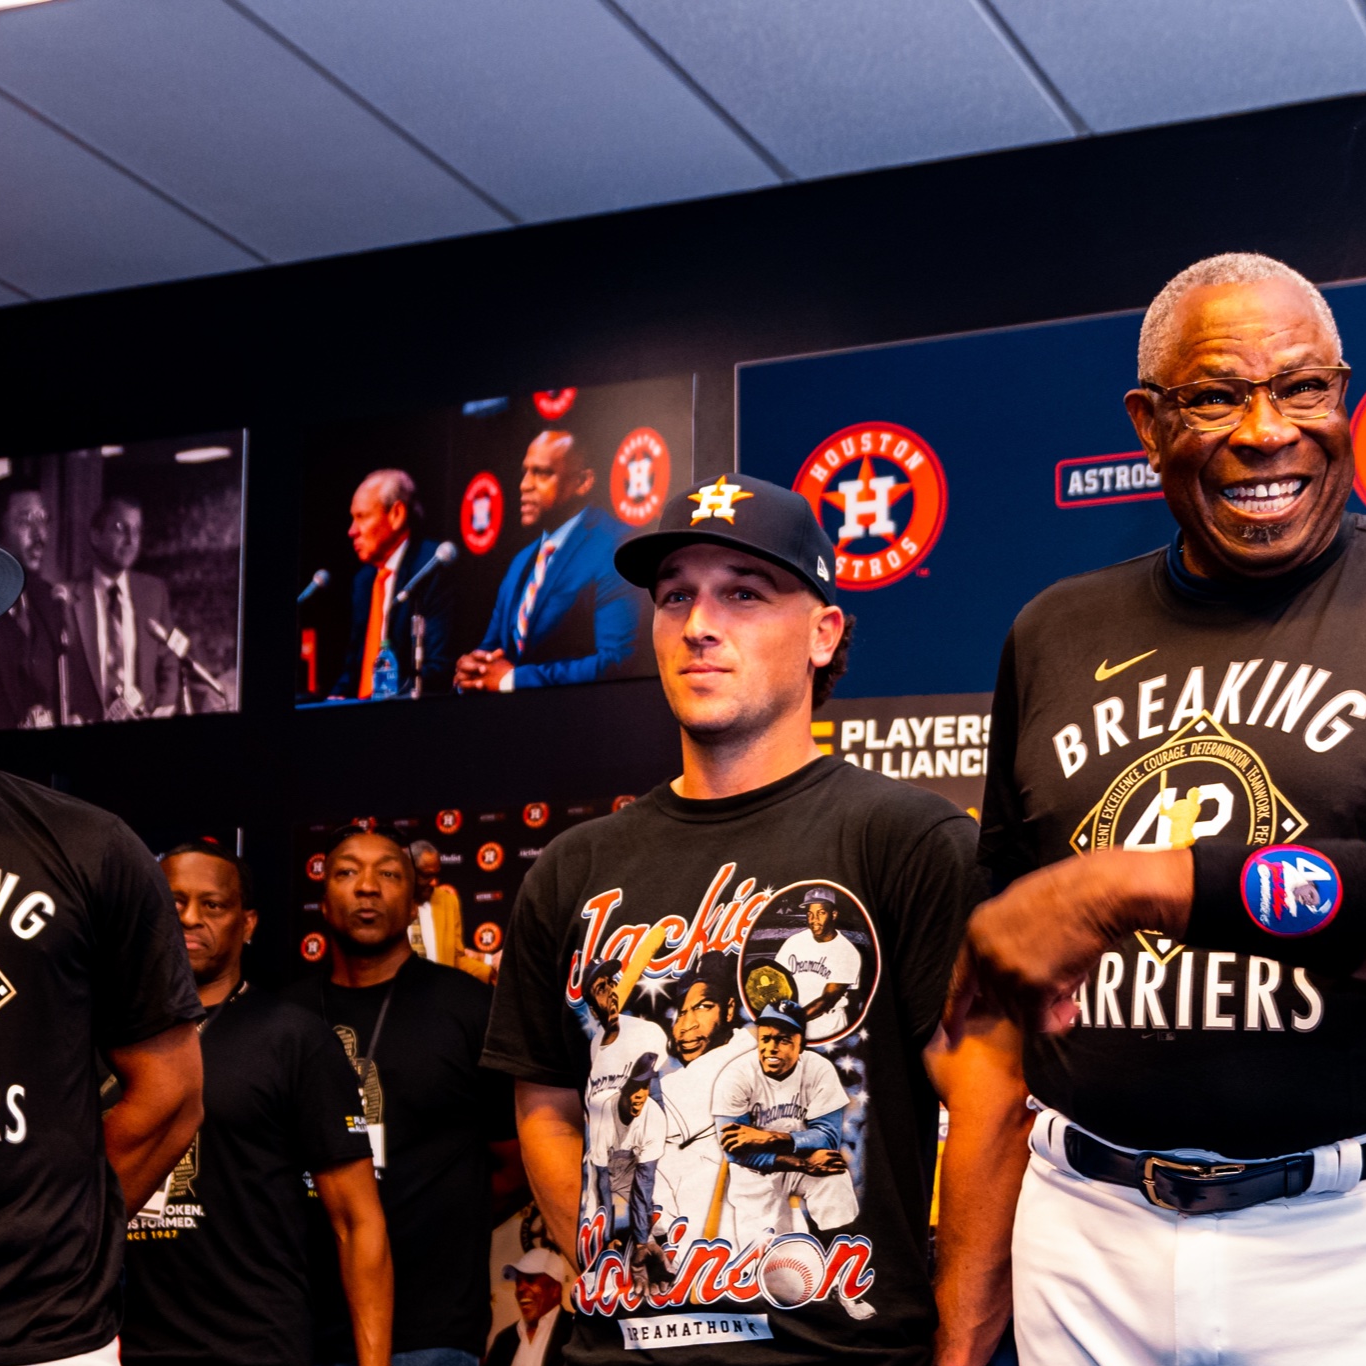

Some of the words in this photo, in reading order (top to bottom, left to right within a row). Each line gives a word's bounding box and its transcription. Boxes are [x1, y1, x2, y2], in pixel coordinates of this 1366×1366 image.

[809, 432, 924, 483] HOUSTON
[1067, 463, 1161, 496] ASTROS
[835, 537, 918, 579] STROS
[1144, 746, 1188, 773] COURAGE.
[1190, 742, 1248, 774] DETERMINATION.
[1245, 764, 1271, 823] TEAMWORK.
[565, 861, 773, 1011] Jackie
[141, 1217, 198, 1229] FORMED.
[151, 1230, 178, 1239] 1947
